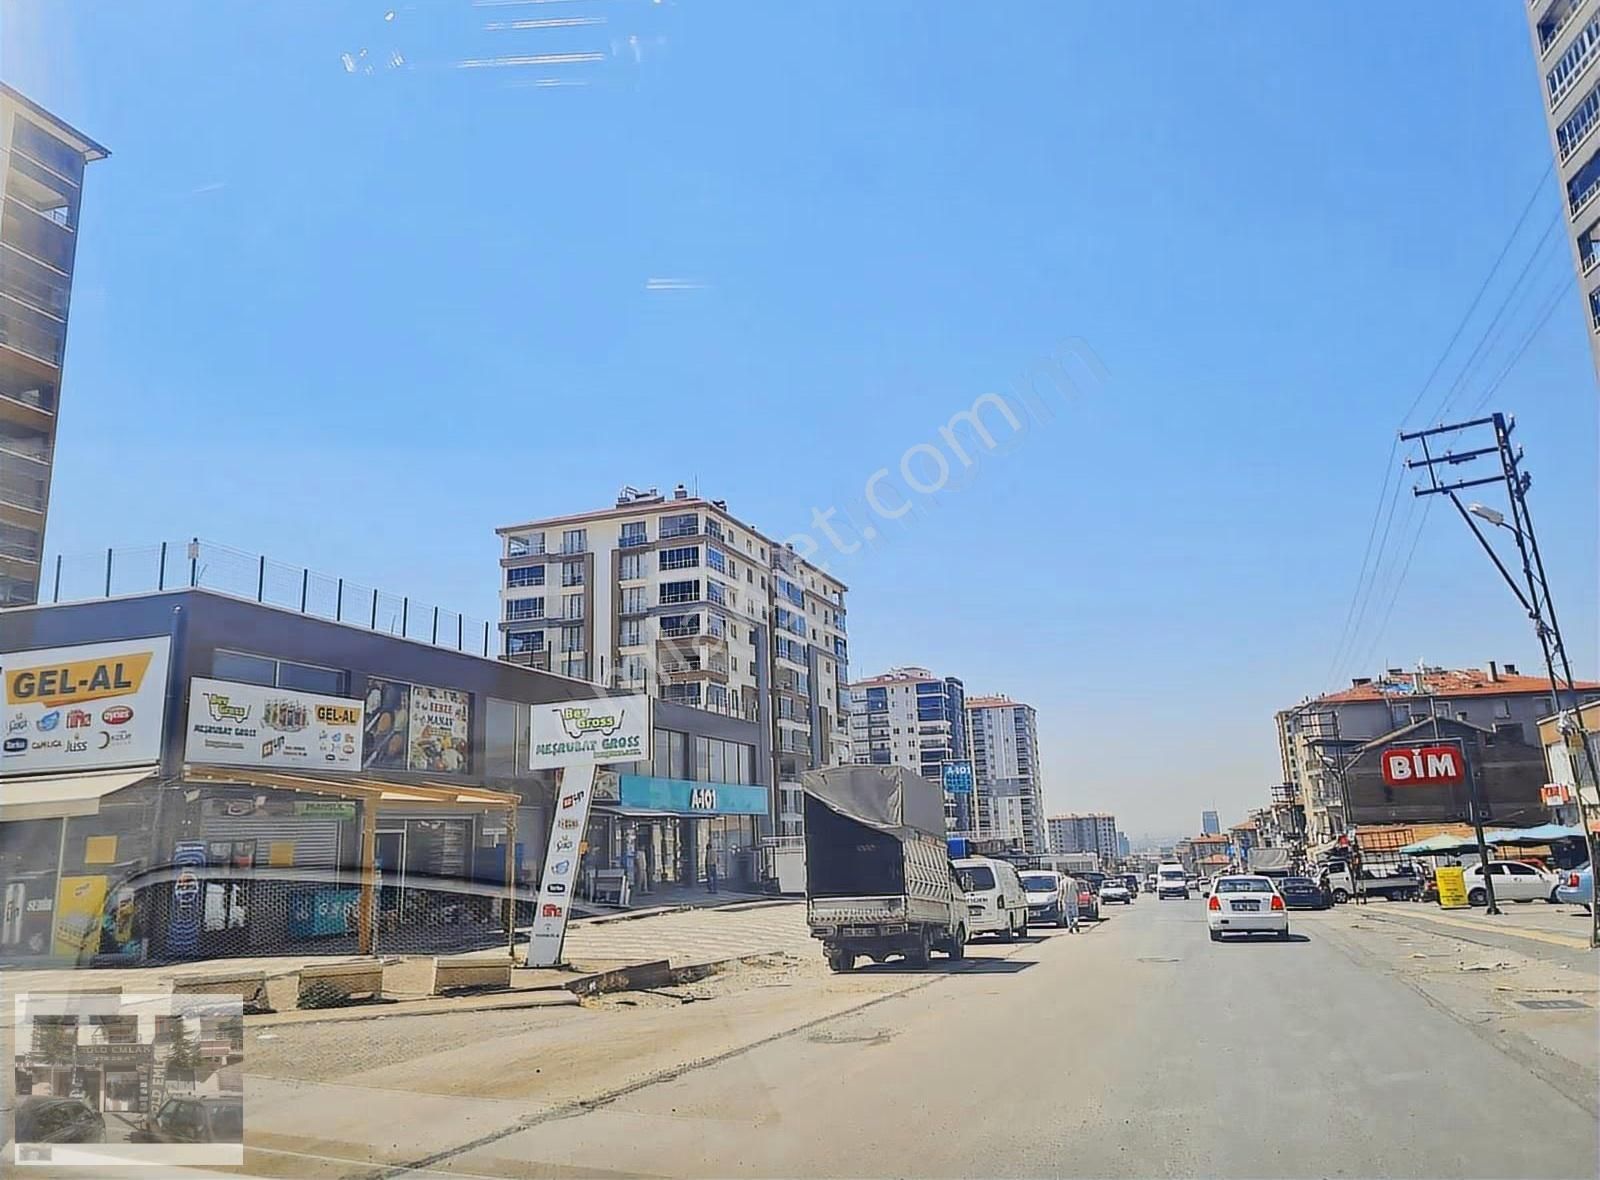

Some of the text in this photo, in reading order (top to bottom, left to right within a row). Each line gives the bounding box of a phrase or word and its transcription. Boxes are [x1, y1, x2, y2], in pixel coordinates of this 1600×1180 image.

[13, 663, 132, 698] GEL-AL
[318, 706, 357, 723] GEL-AL
[577, 716, 615, 729] Gross
[601, 736, 641, 750] GROSS
[1388, 749, 1457, 780] BİM
